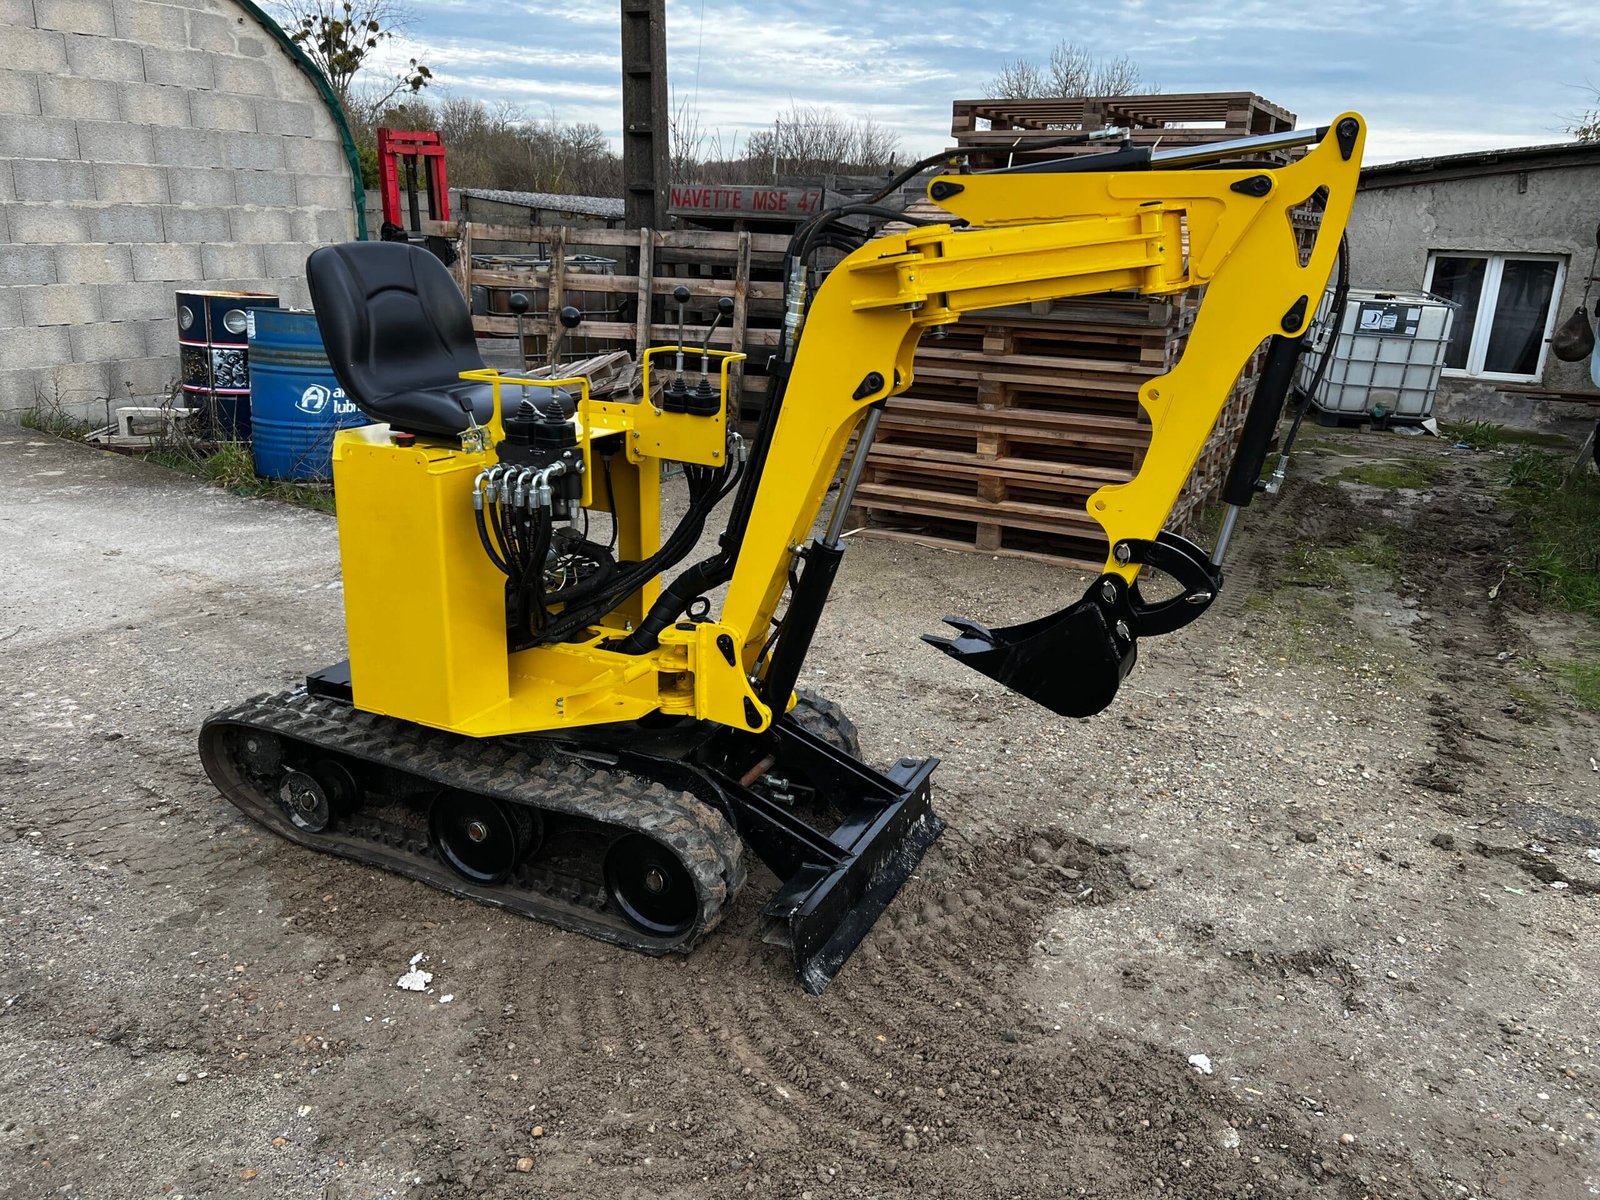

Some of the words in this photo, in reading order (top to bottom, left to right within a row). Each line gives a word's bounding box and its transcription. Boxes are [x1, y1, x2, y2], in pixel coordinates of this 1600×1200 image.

[671, 188, 742, 209] NAVETTE
[753, 191, 789, 211] MSE
[797, 191, 820, 211] 47
